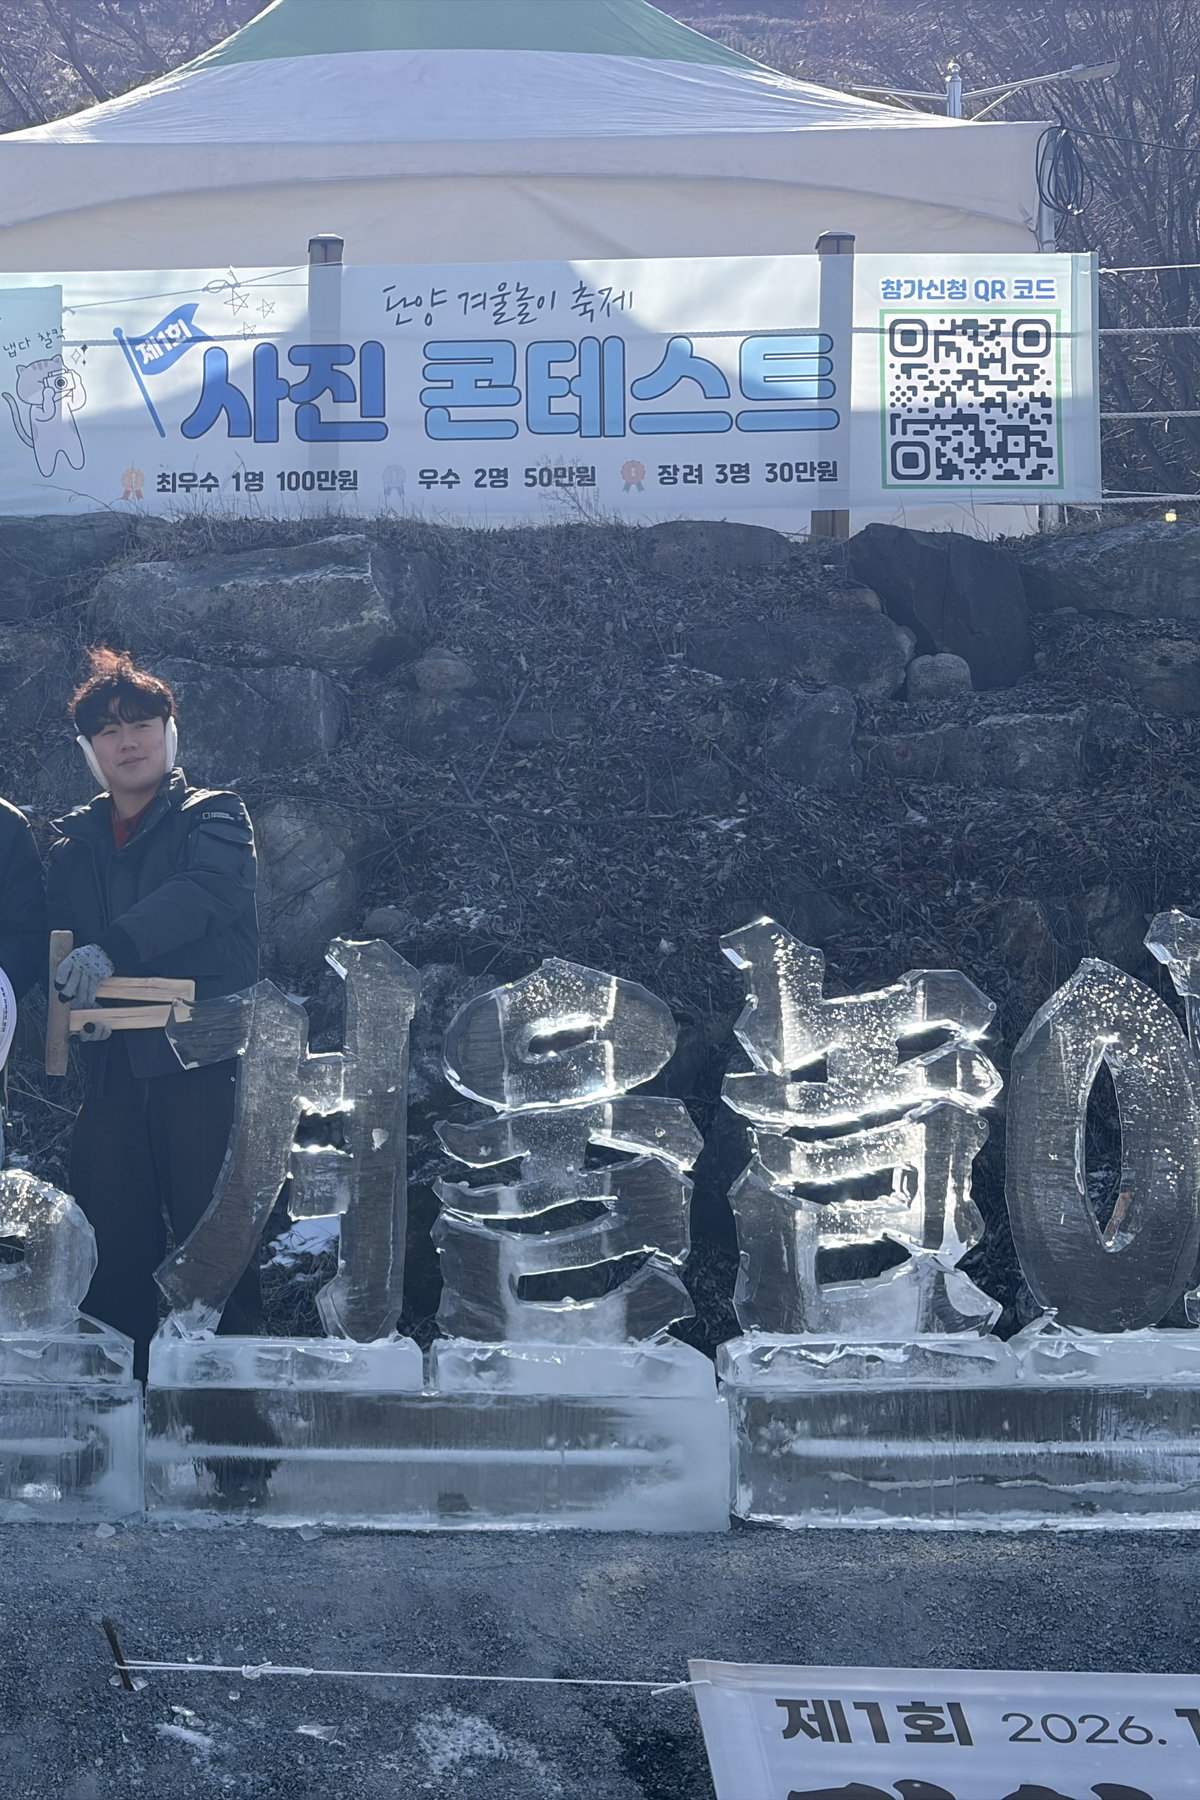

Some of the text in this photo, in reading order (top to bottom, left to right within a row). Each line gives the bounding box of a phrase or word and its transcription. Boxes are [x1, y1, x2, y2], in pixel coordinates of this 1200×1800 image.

[382, 280, 633, 327] 단양 겨울놀이 축제
[881, 278, 1056, 302] 참가신청 QR 코드
[2, 325, 67, 358] 냅다 찰칵
[134, 318, 193, 365] 제1회
[180, 333, 841, 444] 사진 콘테스트
[156, 460, 839, 493] 최우수 1명 100만원 우수 2명 50만원 장려 3명 30만원
[774, 1698, 974, 1746] 제1회
